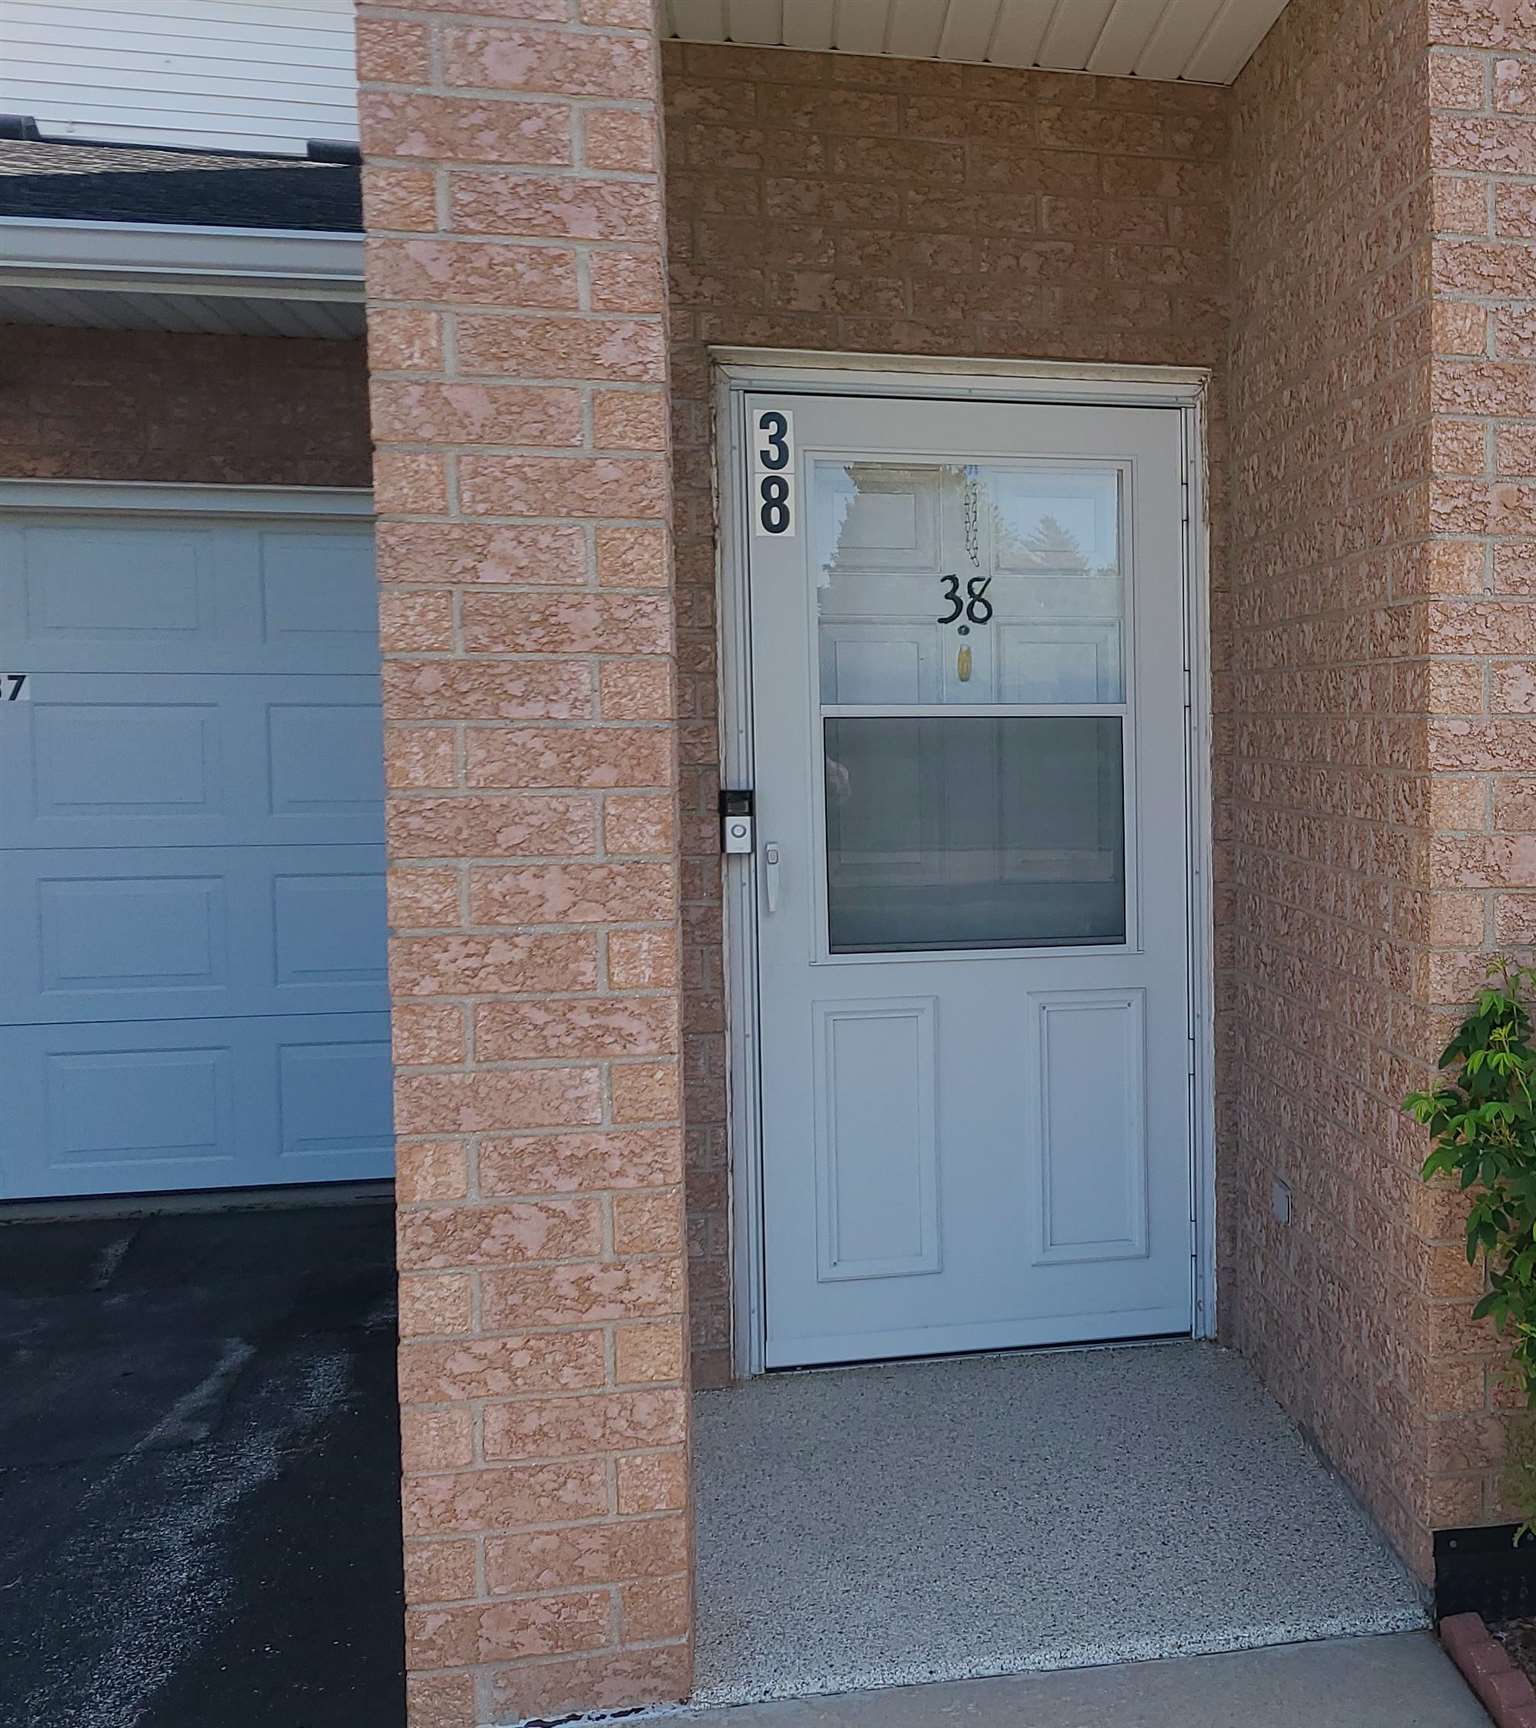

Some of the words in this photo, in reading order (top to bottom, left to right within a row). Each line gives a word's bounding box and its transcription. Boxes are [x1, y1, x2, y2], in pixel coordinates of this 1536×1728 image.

[759, 411, 791, 534] 38
[937, 574, 993, 625] 38
[0, 675, 27, 702] 7
